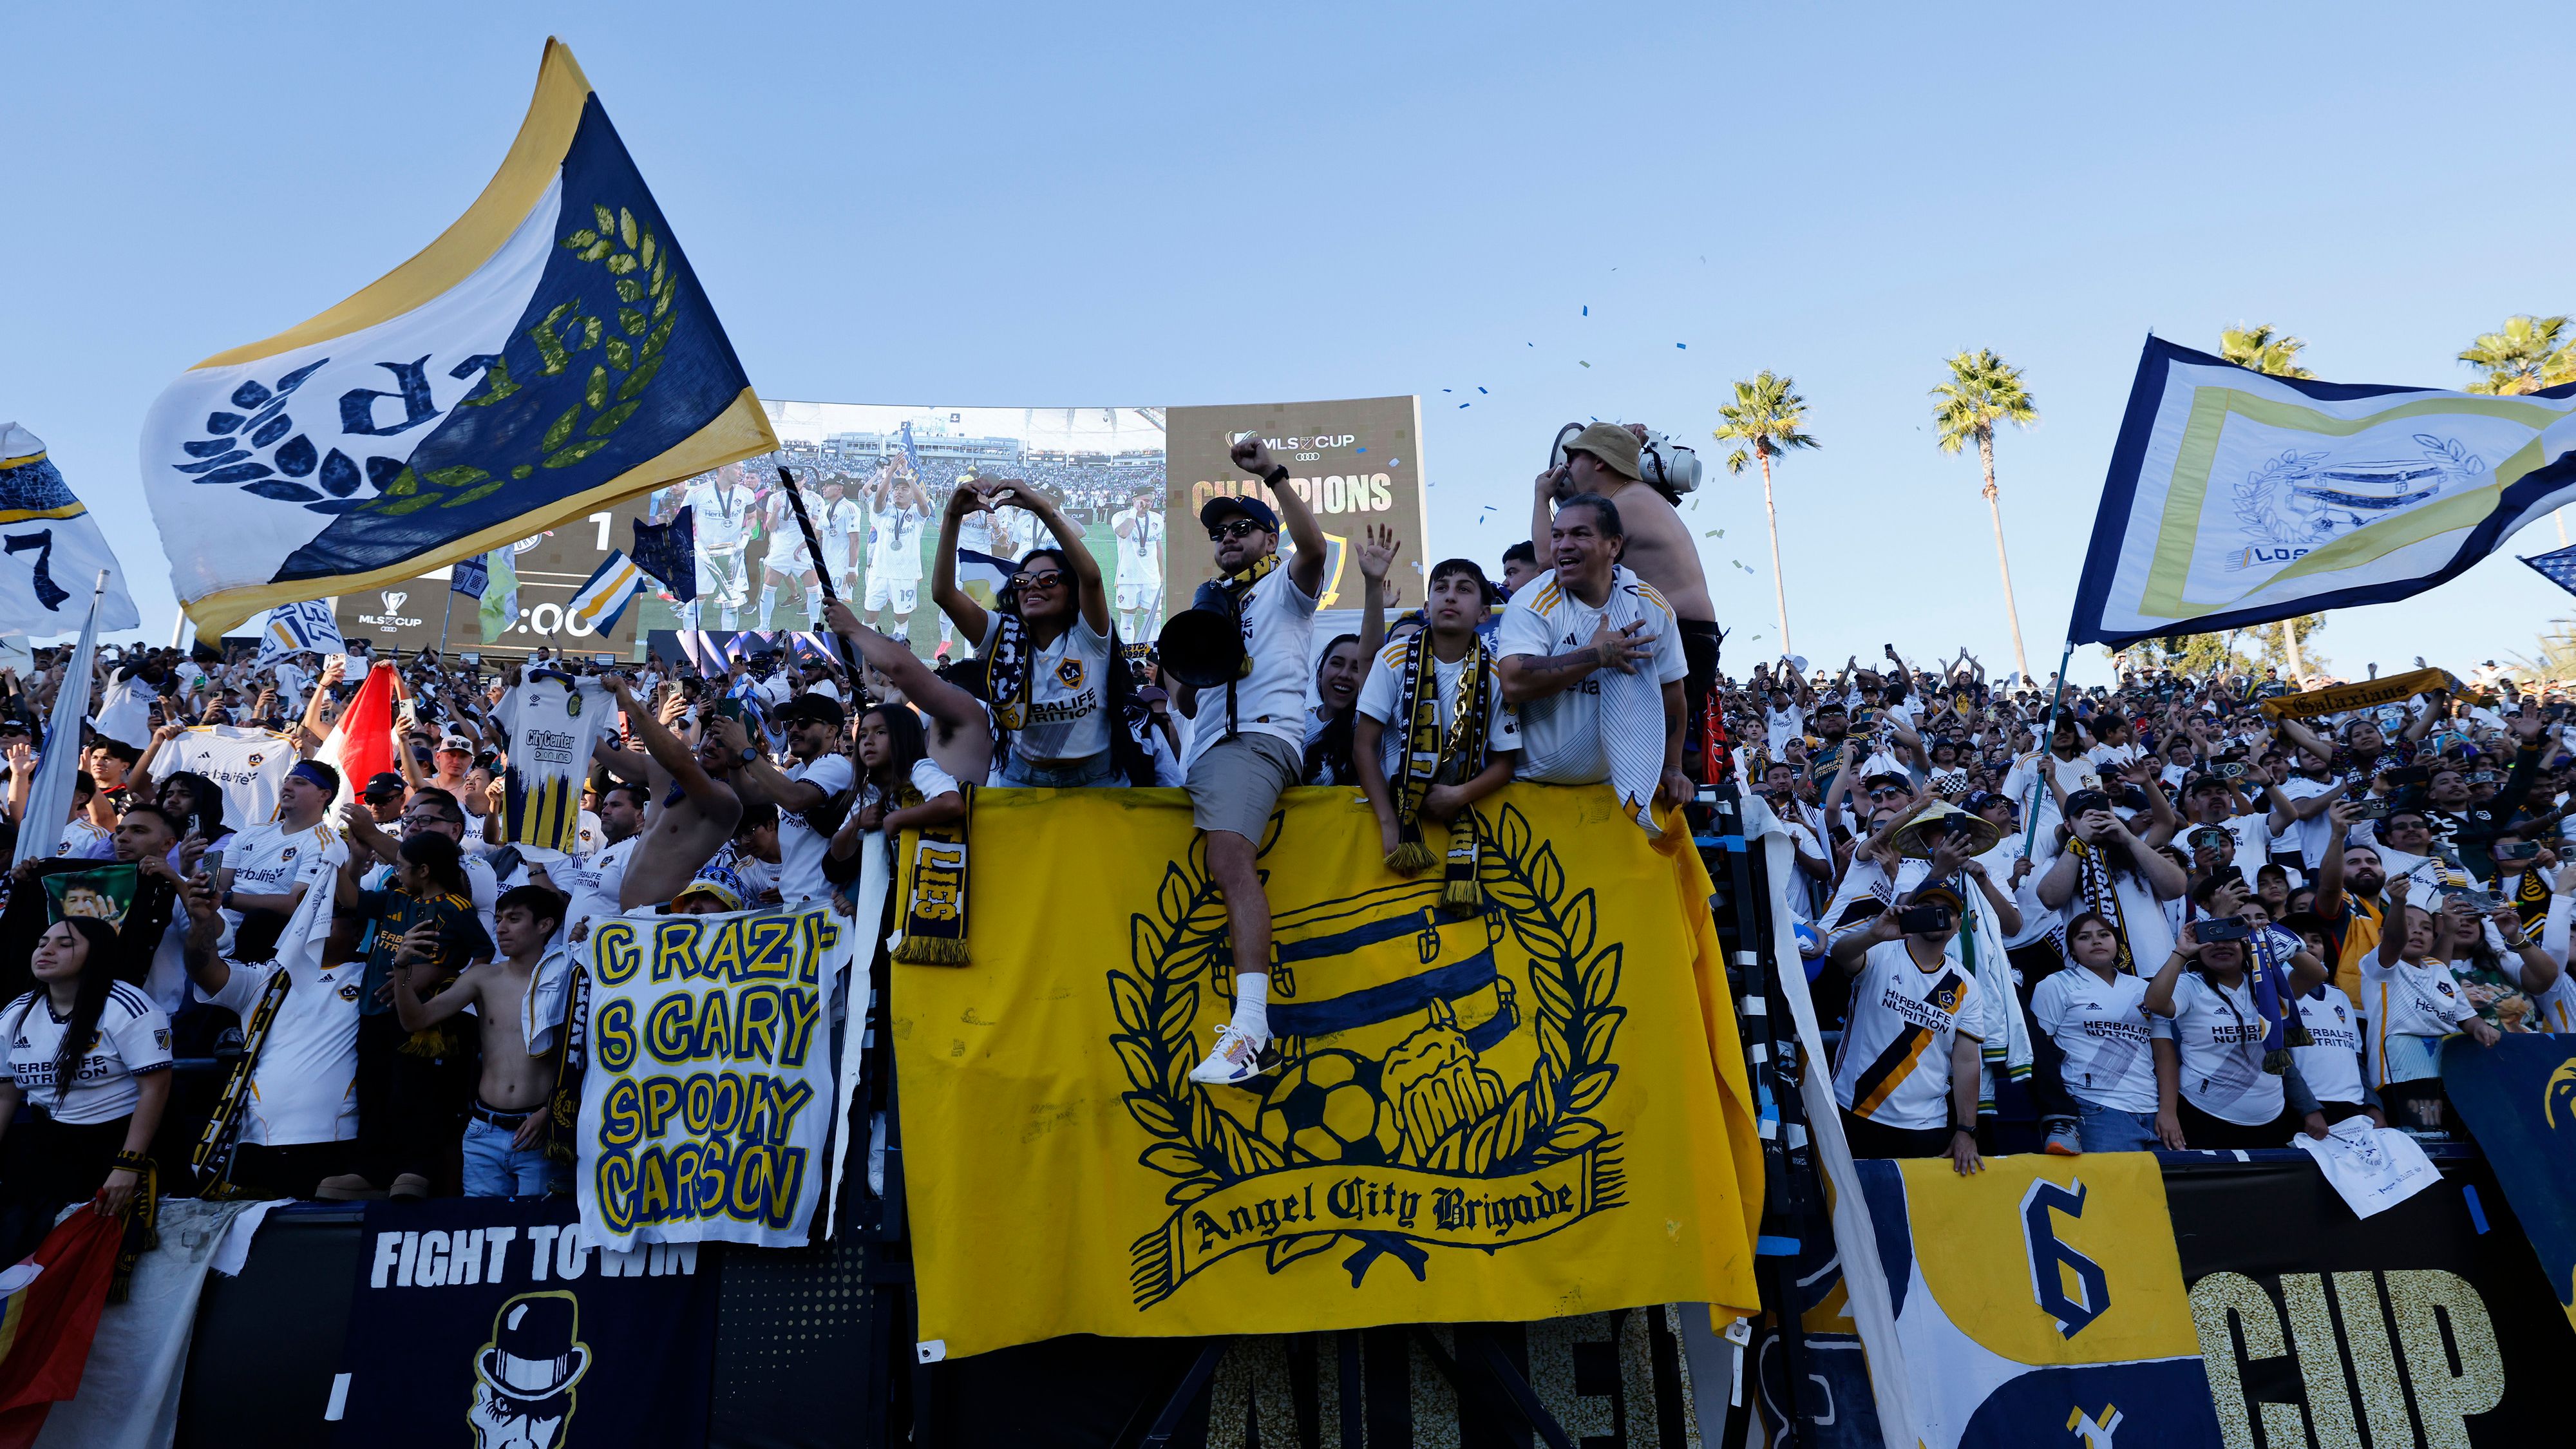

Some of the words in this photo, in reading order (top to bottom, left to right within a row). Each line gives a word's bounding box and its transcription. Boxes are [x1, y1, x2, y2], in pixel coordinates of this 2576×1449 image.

[1262, 437, 1298, 450] MLS
[1315, 435, 1355, 448] CUP
[589, 512, 612, 551] 1
[4, 529, 70, 612] 7
[899, 589, 914, 602] 19
[359, 614, 386, 625] MLS
[395, 617, 422, 627] CUP
[503, 602, 596, 638] :00
[1063, 669, 1081, 681] LA
[1030, 687, 1096, 714] BALIFE
[2293, 683, 2409, 715] Galaxians
[526, 729, 575, 750] CityCenter
[544, 751, 569, 761] ONLINE
[594, 908, 841, 985] CRAZY
[1882, 998, 1949, 1034] NUTRITION
[1885, 988, 1951, 1025] HERBALIFE
[1942, 995, 1953, 1005] LA
[596, 983, 820, 1073] SCARY
[2083, 1020, 2152, 1037] HERBALIFE
[594, 1140, 810, 1236] CARSON
[1192, 1182, 1316, 1255] Angel
[1327, 1177, 1422, 1229] City
[1430, 1180, 1575, 1237] Brigade
[370, 1226, 516, 1289] FIGHT
[528, 1222, 591, 1282] TO
[2018, 1175, 2112, 1341] 6
[2188, 1269, 2506, 1449] CUP
